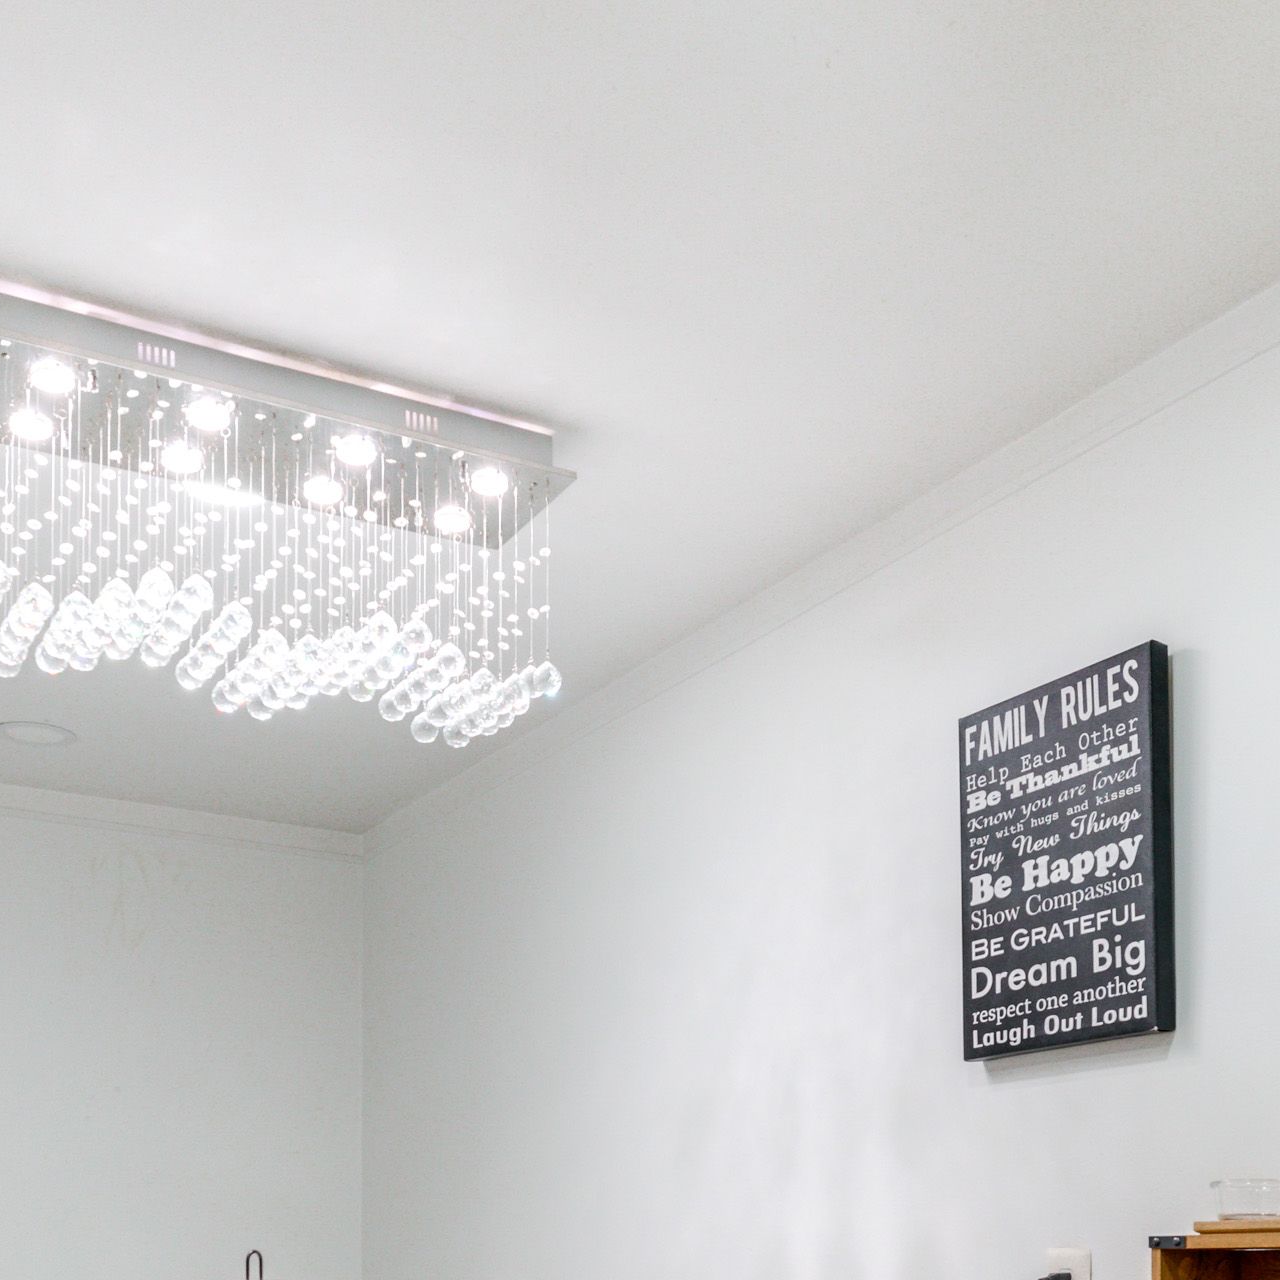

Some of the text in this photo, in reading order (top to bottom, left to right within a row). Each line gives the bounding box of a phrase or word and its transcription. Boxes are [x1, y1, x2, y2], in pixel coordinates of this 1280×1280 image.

[965, 659, 1139, 766] FAMILY RULES
[966, 717, 1138, 792] Help Each Other
[966, 734, 1141, 814] Be Thankful
[968, 757, 1142, 832] Know you are loved
[969, 784, 1141, 848] Pay with hugs and kisses
[969, 808, 1141, 873] Try New Things
[970, 834, 1144, 906] Be Happy
[971, 872, 1143, 931] Show Compassion
[1010, 902, 1146, 951] GRATEFUL
[971, 934, 1146, 1000] Dream Big
[972, 976, 1146, 1026] respect one another
[972, 995, 1148, 1049] Laugh Out Loud
